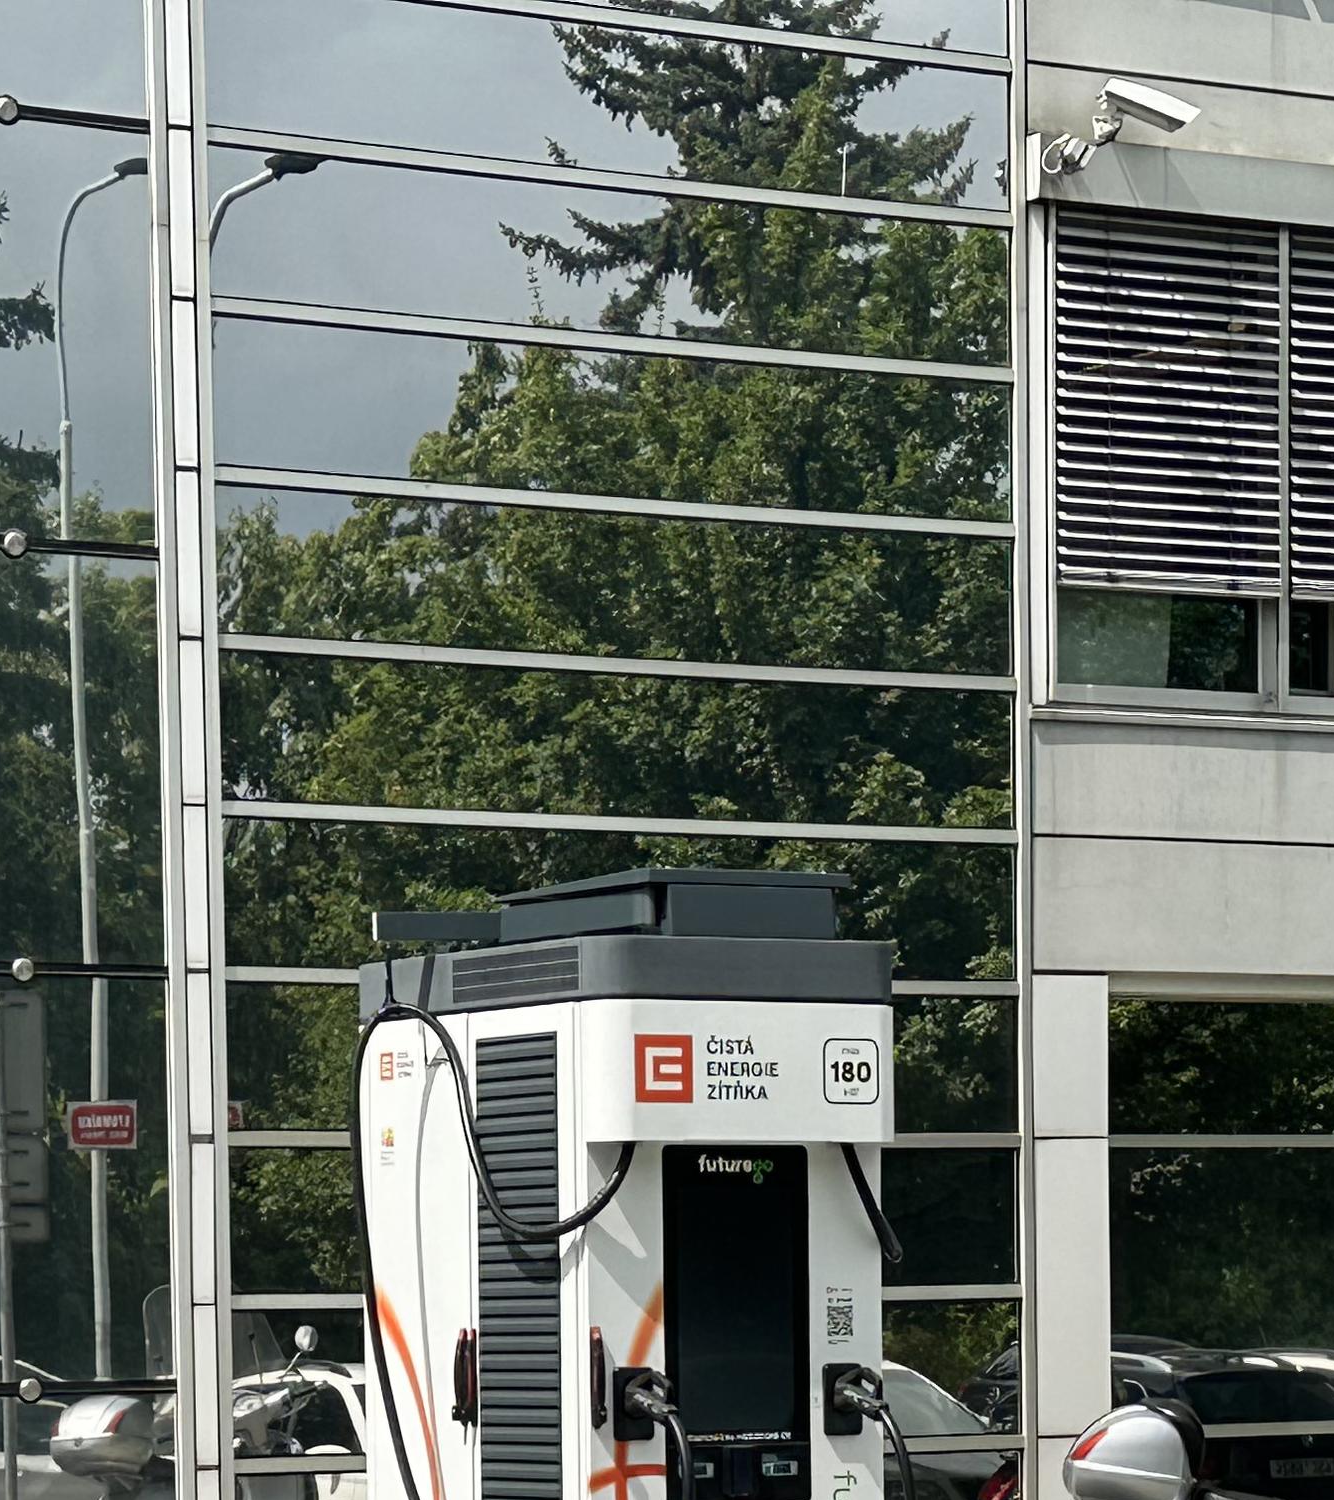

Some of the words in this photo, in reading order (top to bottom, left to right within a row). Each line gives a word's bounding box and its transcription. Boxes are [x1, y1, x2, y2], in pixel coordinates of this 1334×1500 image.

[706, 1034, 755, 1055] ČISTÁ
[706, 1061, 779, 1077] ENERGIE
[830, 1060, 872, 1083] 180
